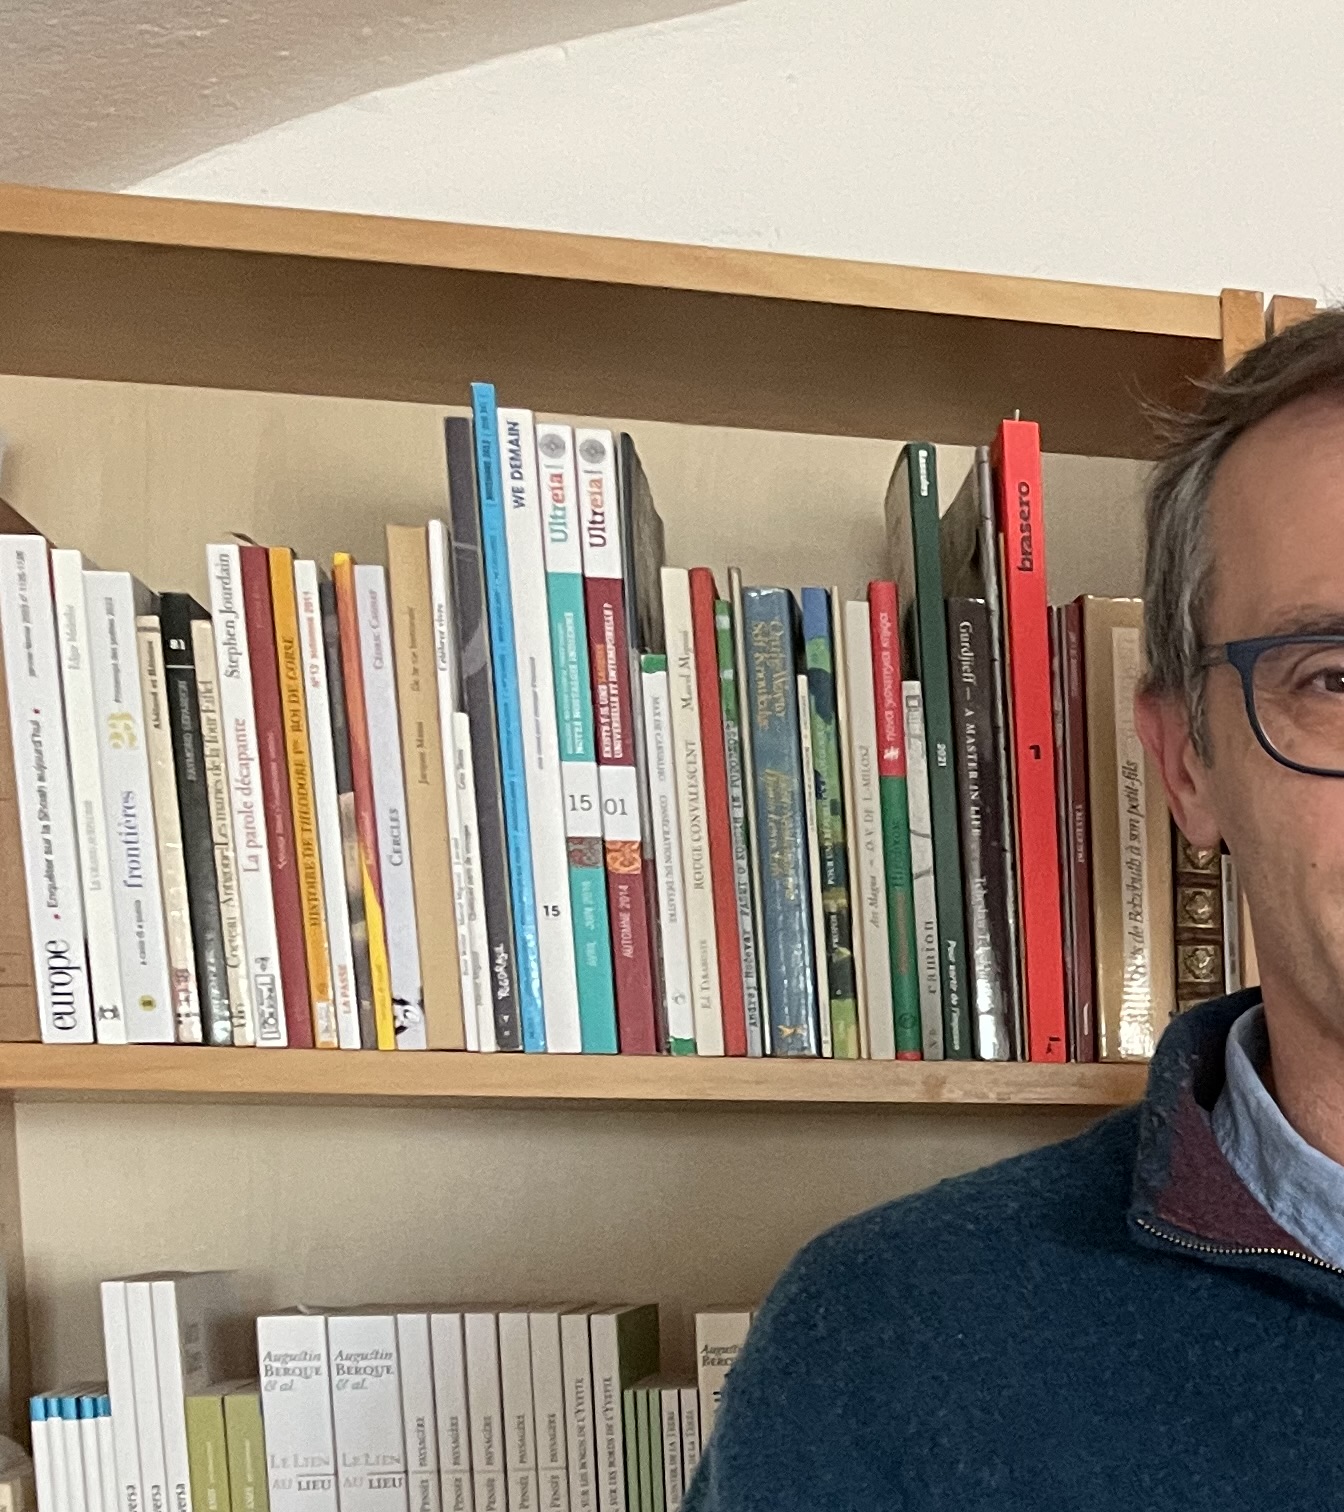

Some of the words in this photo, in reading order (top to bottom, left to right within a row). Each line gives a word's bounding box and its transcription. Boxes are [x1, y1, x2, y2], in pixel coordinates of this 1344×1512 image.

[505, 421, 525, 482] DEMAIN
[510, 486, 528, 510] WE
[1016, 481, 1034, 572] brasero
[214, 553, 238, 615] Jourdain
[221, 619, 246, 680] Stephen
[957, 621, 976, 684] Gurdjieff
[107, 712, 138, 749] 23
[230, 718, 255, 796] décapante
[567, 791, 593, 813] 15
[682, 739, 705, 842] CONVALESCENT
[602, 796, 628, 817] 01
[39, 824, 51, 835] la
[116, 791, 143, 889] frontières
[237, 802, 261, 850] parole
[385, 808, 405, 867] CERCLES
[1128, 818, 1142, 843] son
[41, 838, 53, 855] sur
[241, 855, 259, 872] La
[688, 848, 707, 890] ROUGE
[301, 862, 321, 928] HISTOIRE
[617, 884, 632, 909] 2014
[543, 904, 561, 919] 15
[618, 913, 635, 960] AUTOMNE
[45, 939, 80, 1033] europe
[263, 1350, 321, 1365] Augustin
[264, 1364, 322, 1380] BERQUE
[334, 1349, 393, 1364] Augustin
[335, 1363, 394, 1378] BERQUE
[297, 1479, 332, 1492] LIEU
[368, 1476, 403, 1490] LIEU
